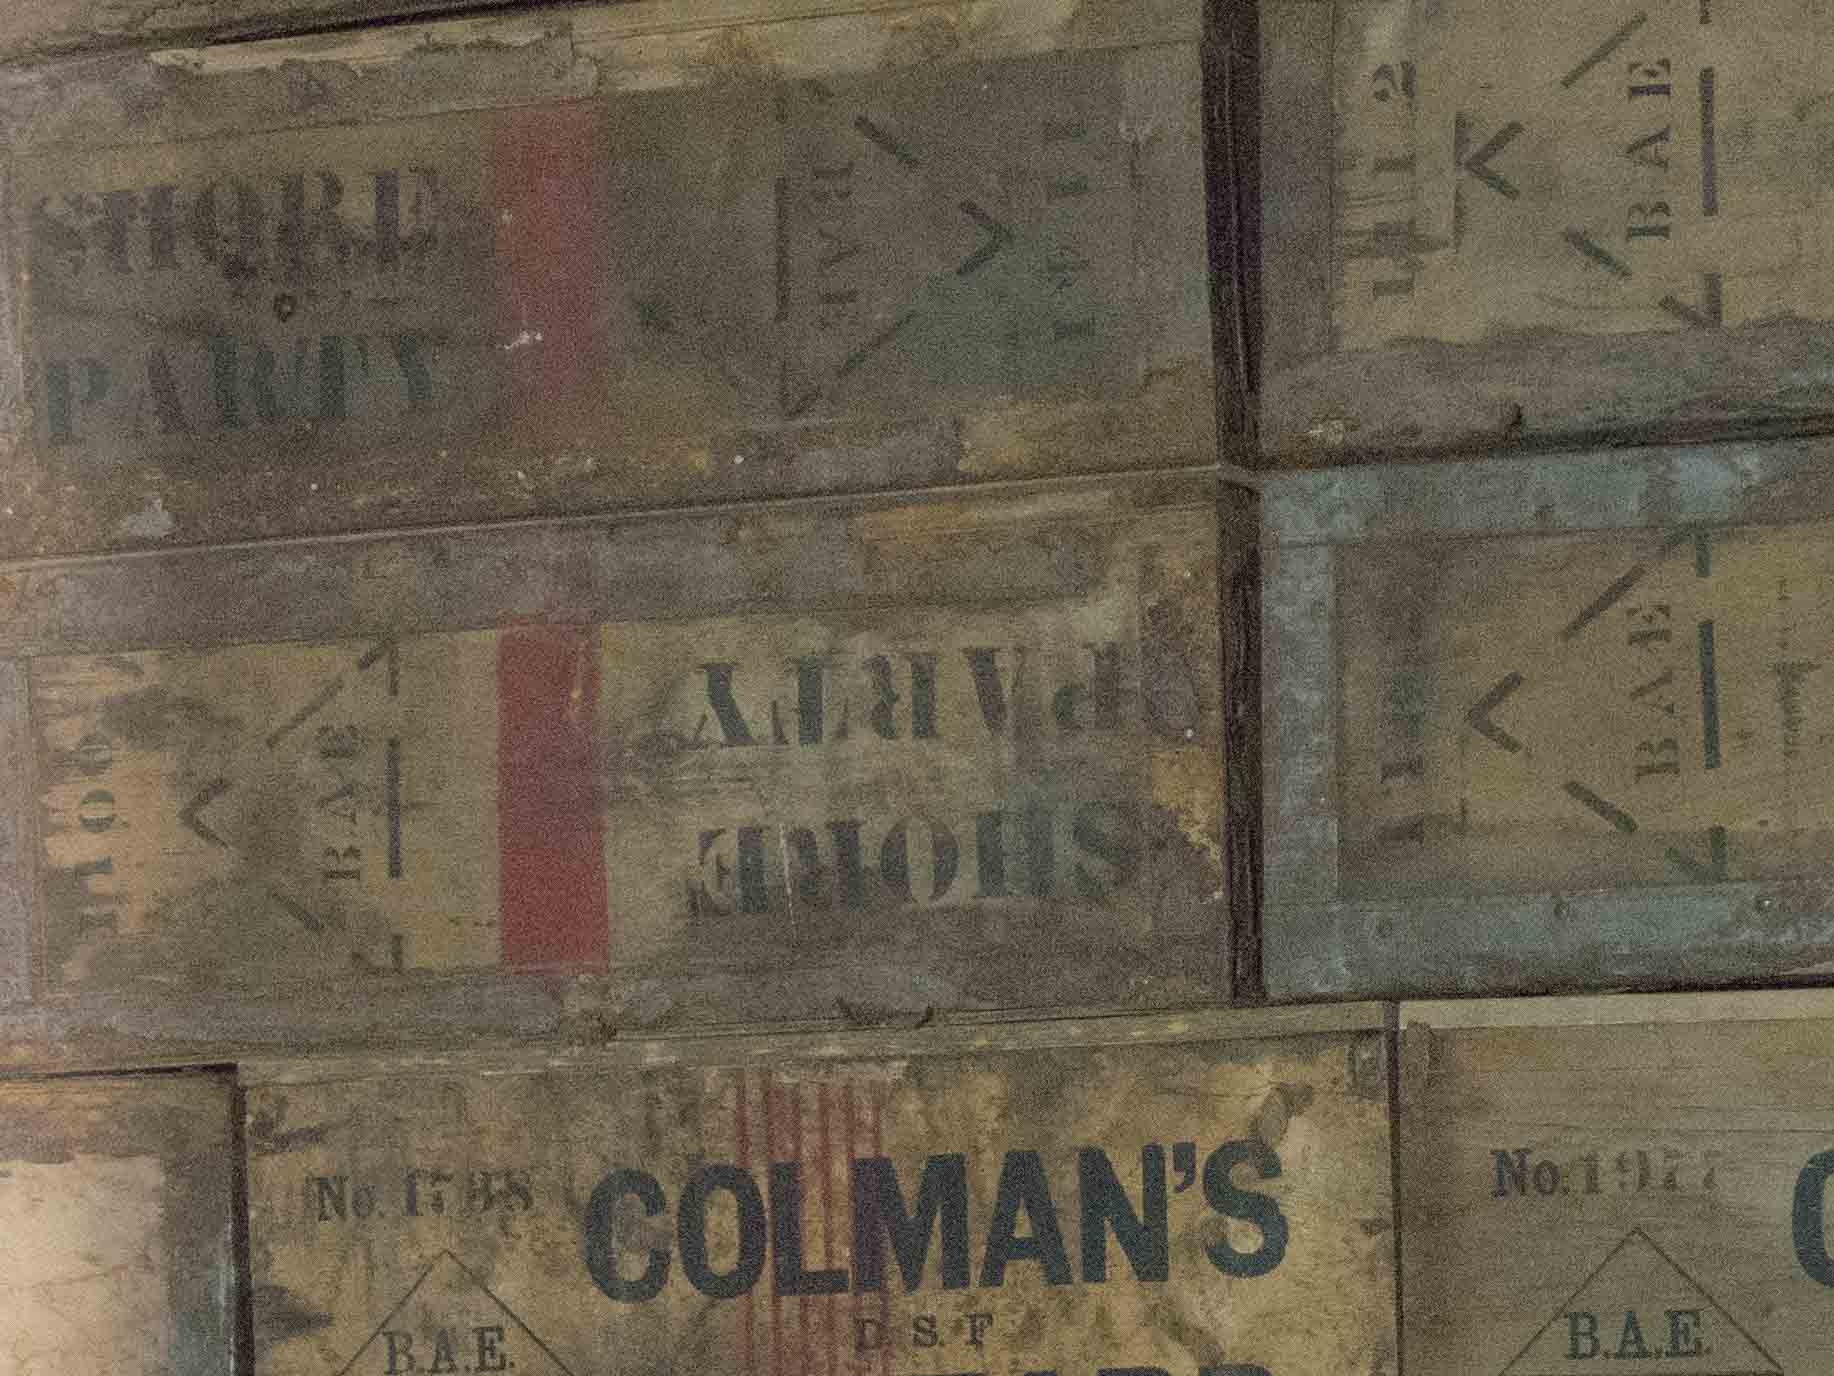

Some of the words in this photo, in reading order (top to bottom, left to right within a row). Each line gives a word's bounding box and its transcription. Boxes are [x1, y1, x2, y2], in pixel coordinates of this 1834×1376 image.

[1625, 58, 1673, 242] BAE
[583, 1139, 1290, 1304] COLMAN'S
[1563, 1308, 1713, 1362] B.A.E.
